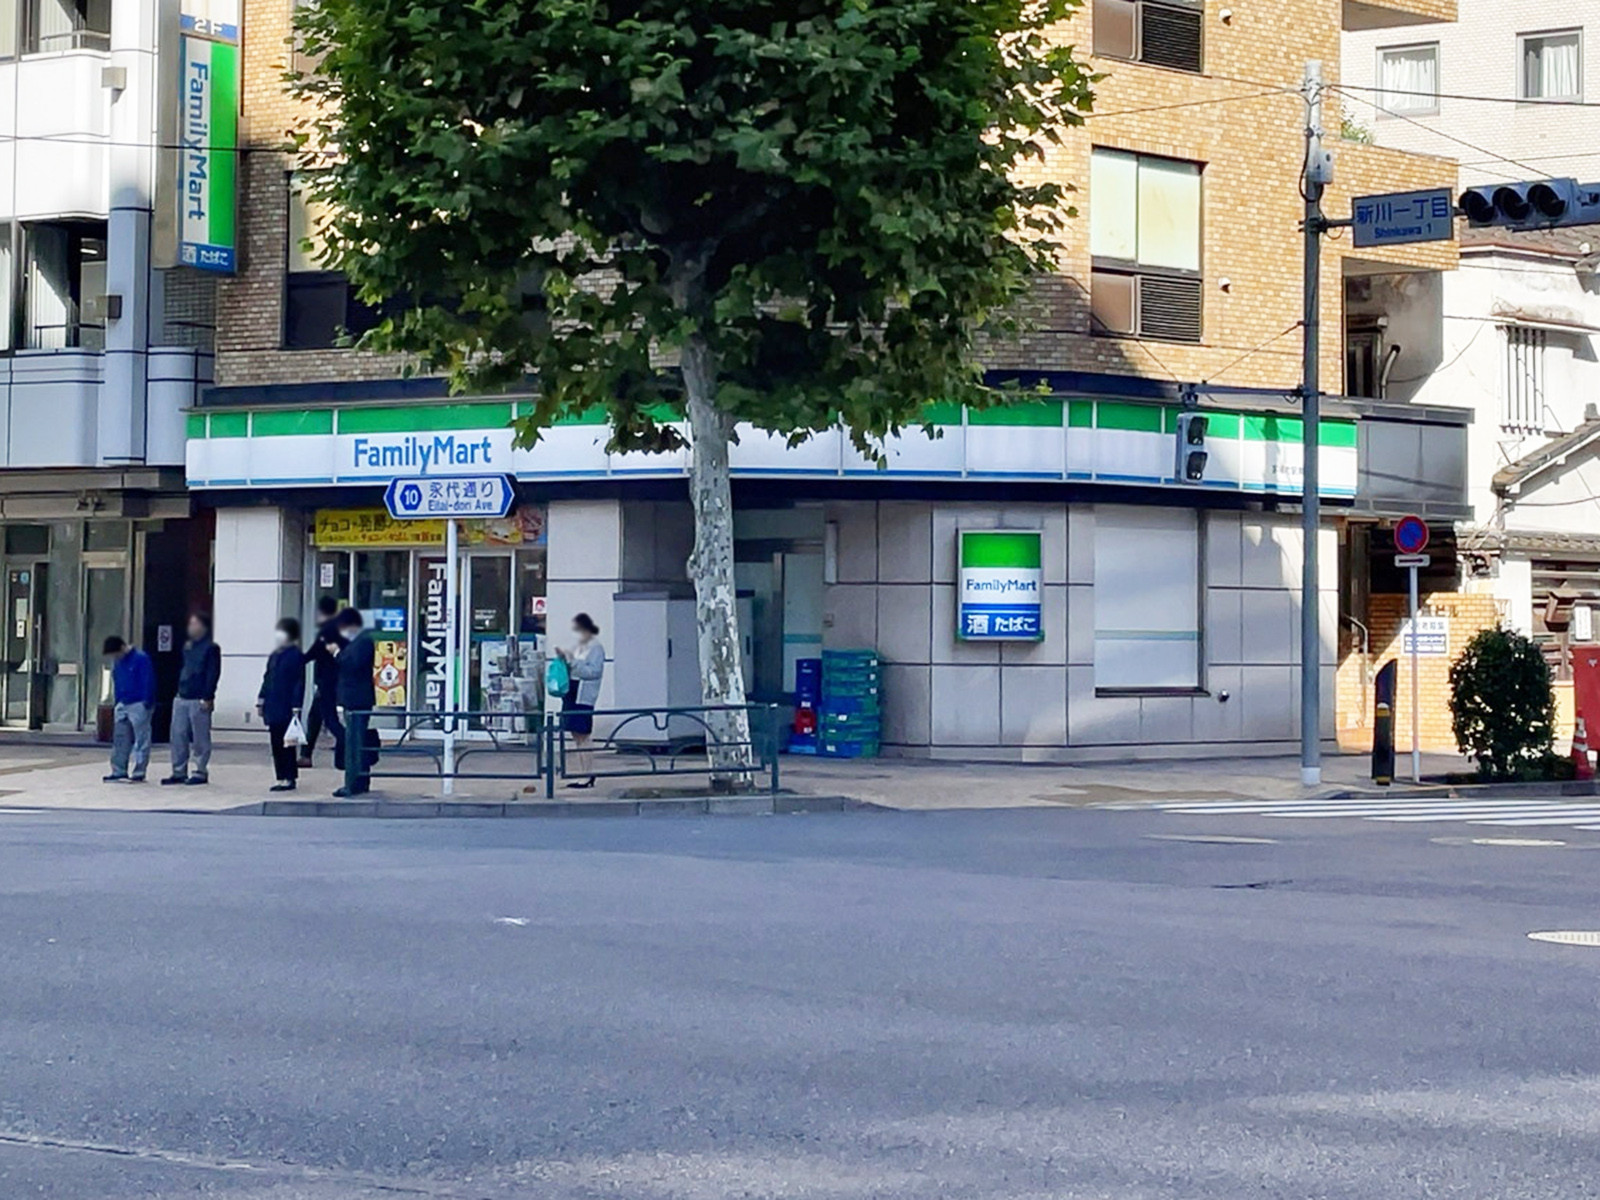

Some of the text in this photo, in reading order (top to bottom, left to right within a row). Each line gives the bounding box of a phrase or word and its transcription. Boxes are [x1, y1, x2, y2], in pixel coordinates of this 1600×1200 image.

[194, 17, 223, 35] 2F
[184, 61, 209, 220] FamilyMart
[1356, 197, 1448, 225] 新川一丁目
[1374, 223, 1432, 239] Shinkawa 1
[354, 436, 492, 473] FamilyMart
[404, 490, 418, 505] 10
[428, 481, 494, 498] 永代通り
[966, 579, 1037, 593] FamilyMart
[967, 615, 1037, 634] 酒 たばこ
[421, 562, 448, 723] FamilyMar
